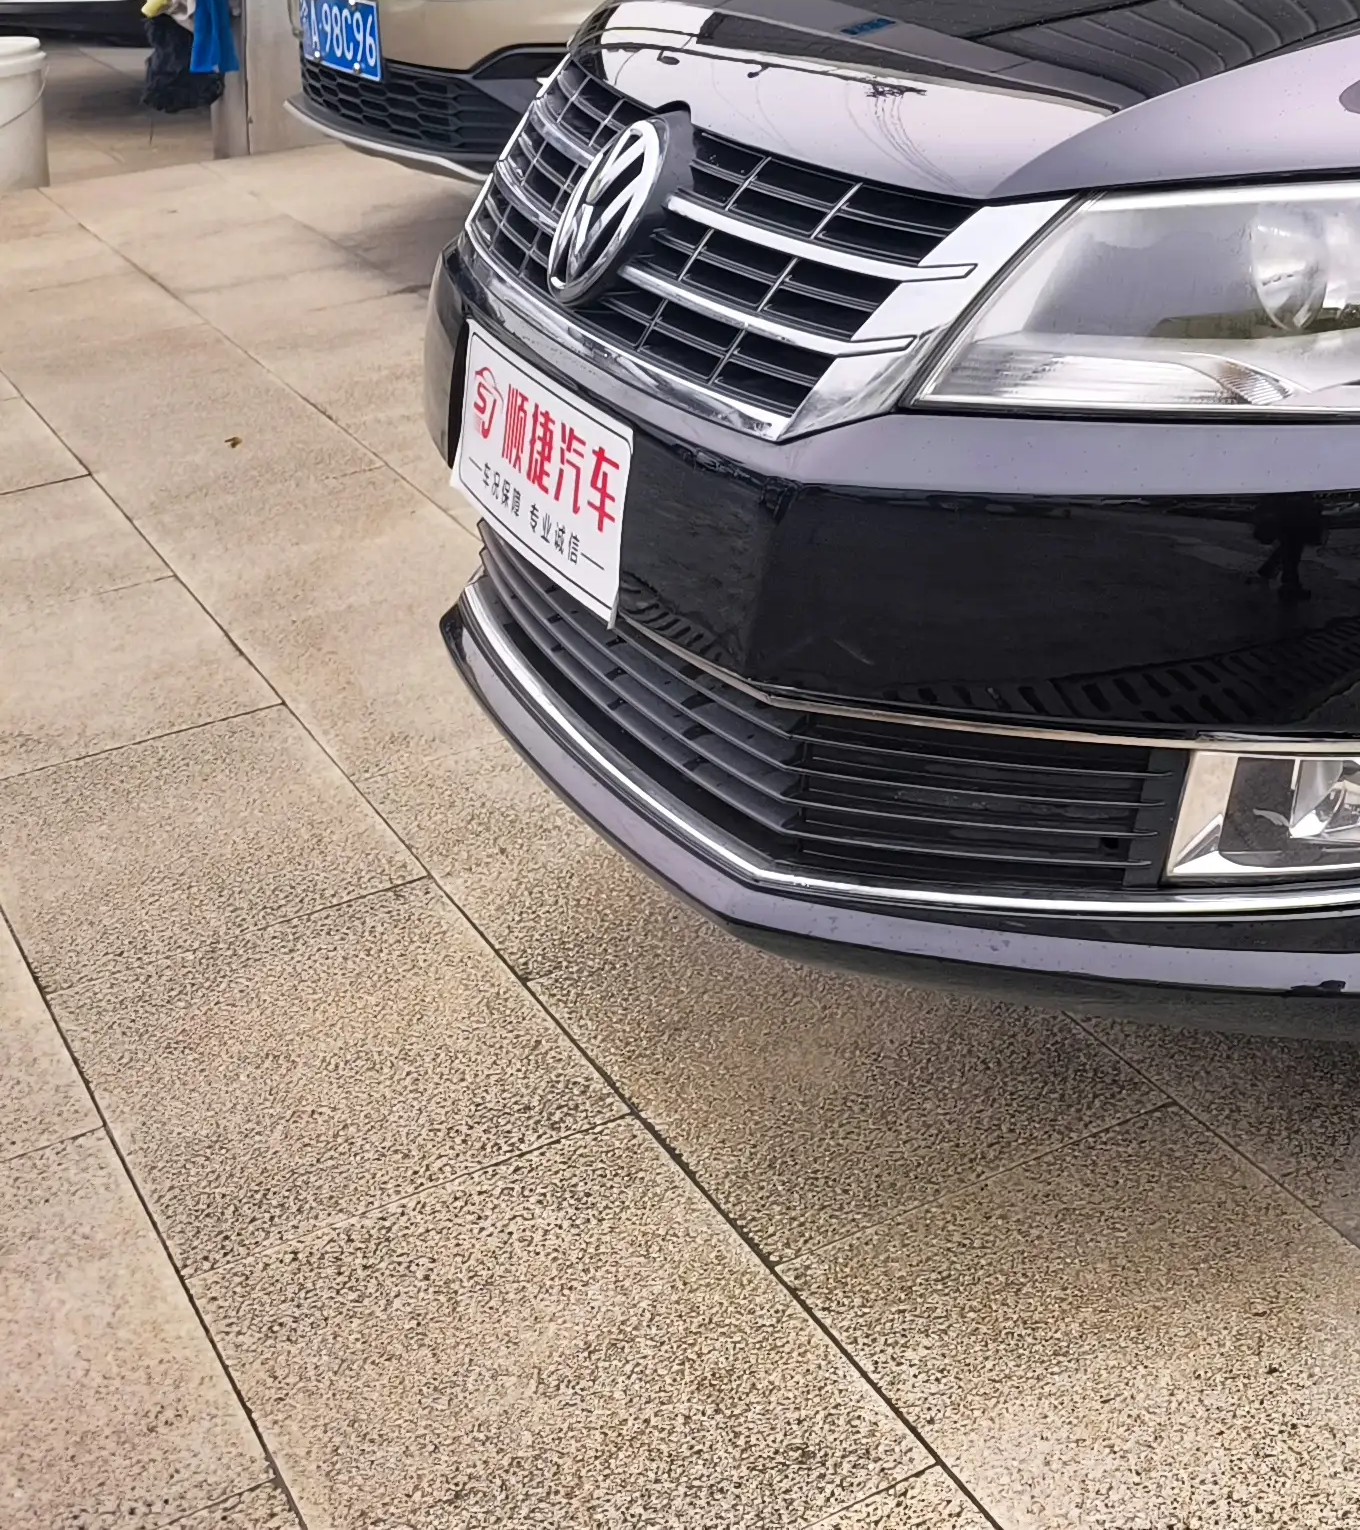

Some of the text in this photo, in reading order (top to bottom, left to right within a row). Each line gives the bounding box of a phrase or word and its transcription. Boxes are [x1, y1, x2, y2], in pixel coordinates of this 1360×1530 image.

[501, 383, 620, 533] 顺捷汽车
[481, 461, 523, 518] 车况保障
[528, 503, 581, 565] 专业诚信
